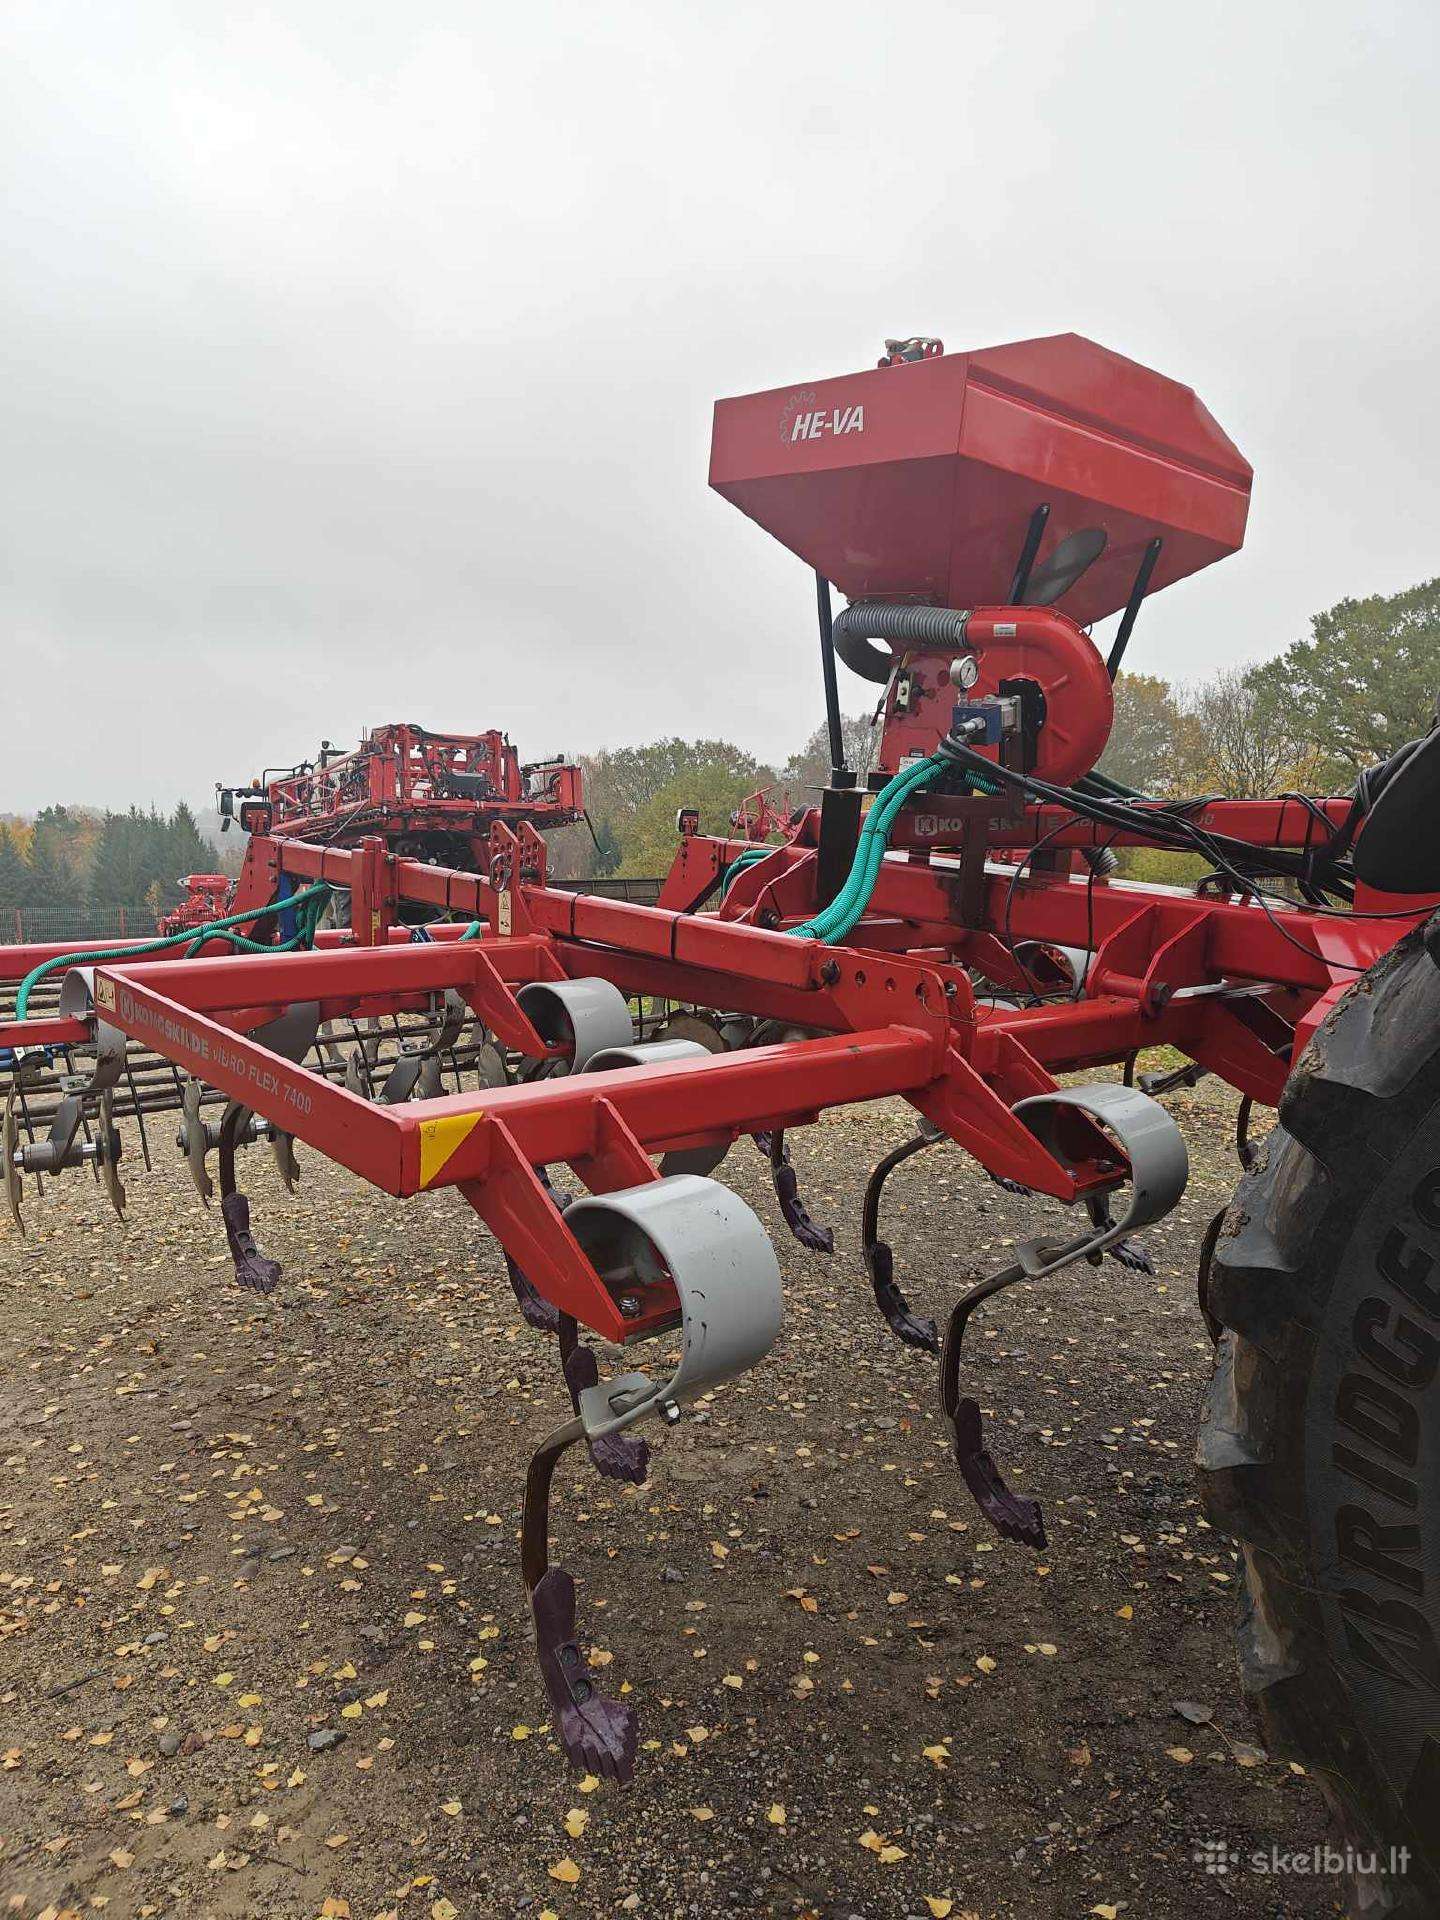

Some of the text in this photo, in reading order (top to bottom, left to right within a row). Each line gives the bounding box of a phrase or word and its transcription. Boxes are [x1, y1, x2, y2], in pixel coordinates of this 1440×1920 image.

[791, 405, 863, 441] HE-VA
[248, 1064, 280, 1096] FLEX
[283, 1083, 312, 1115] 7400
